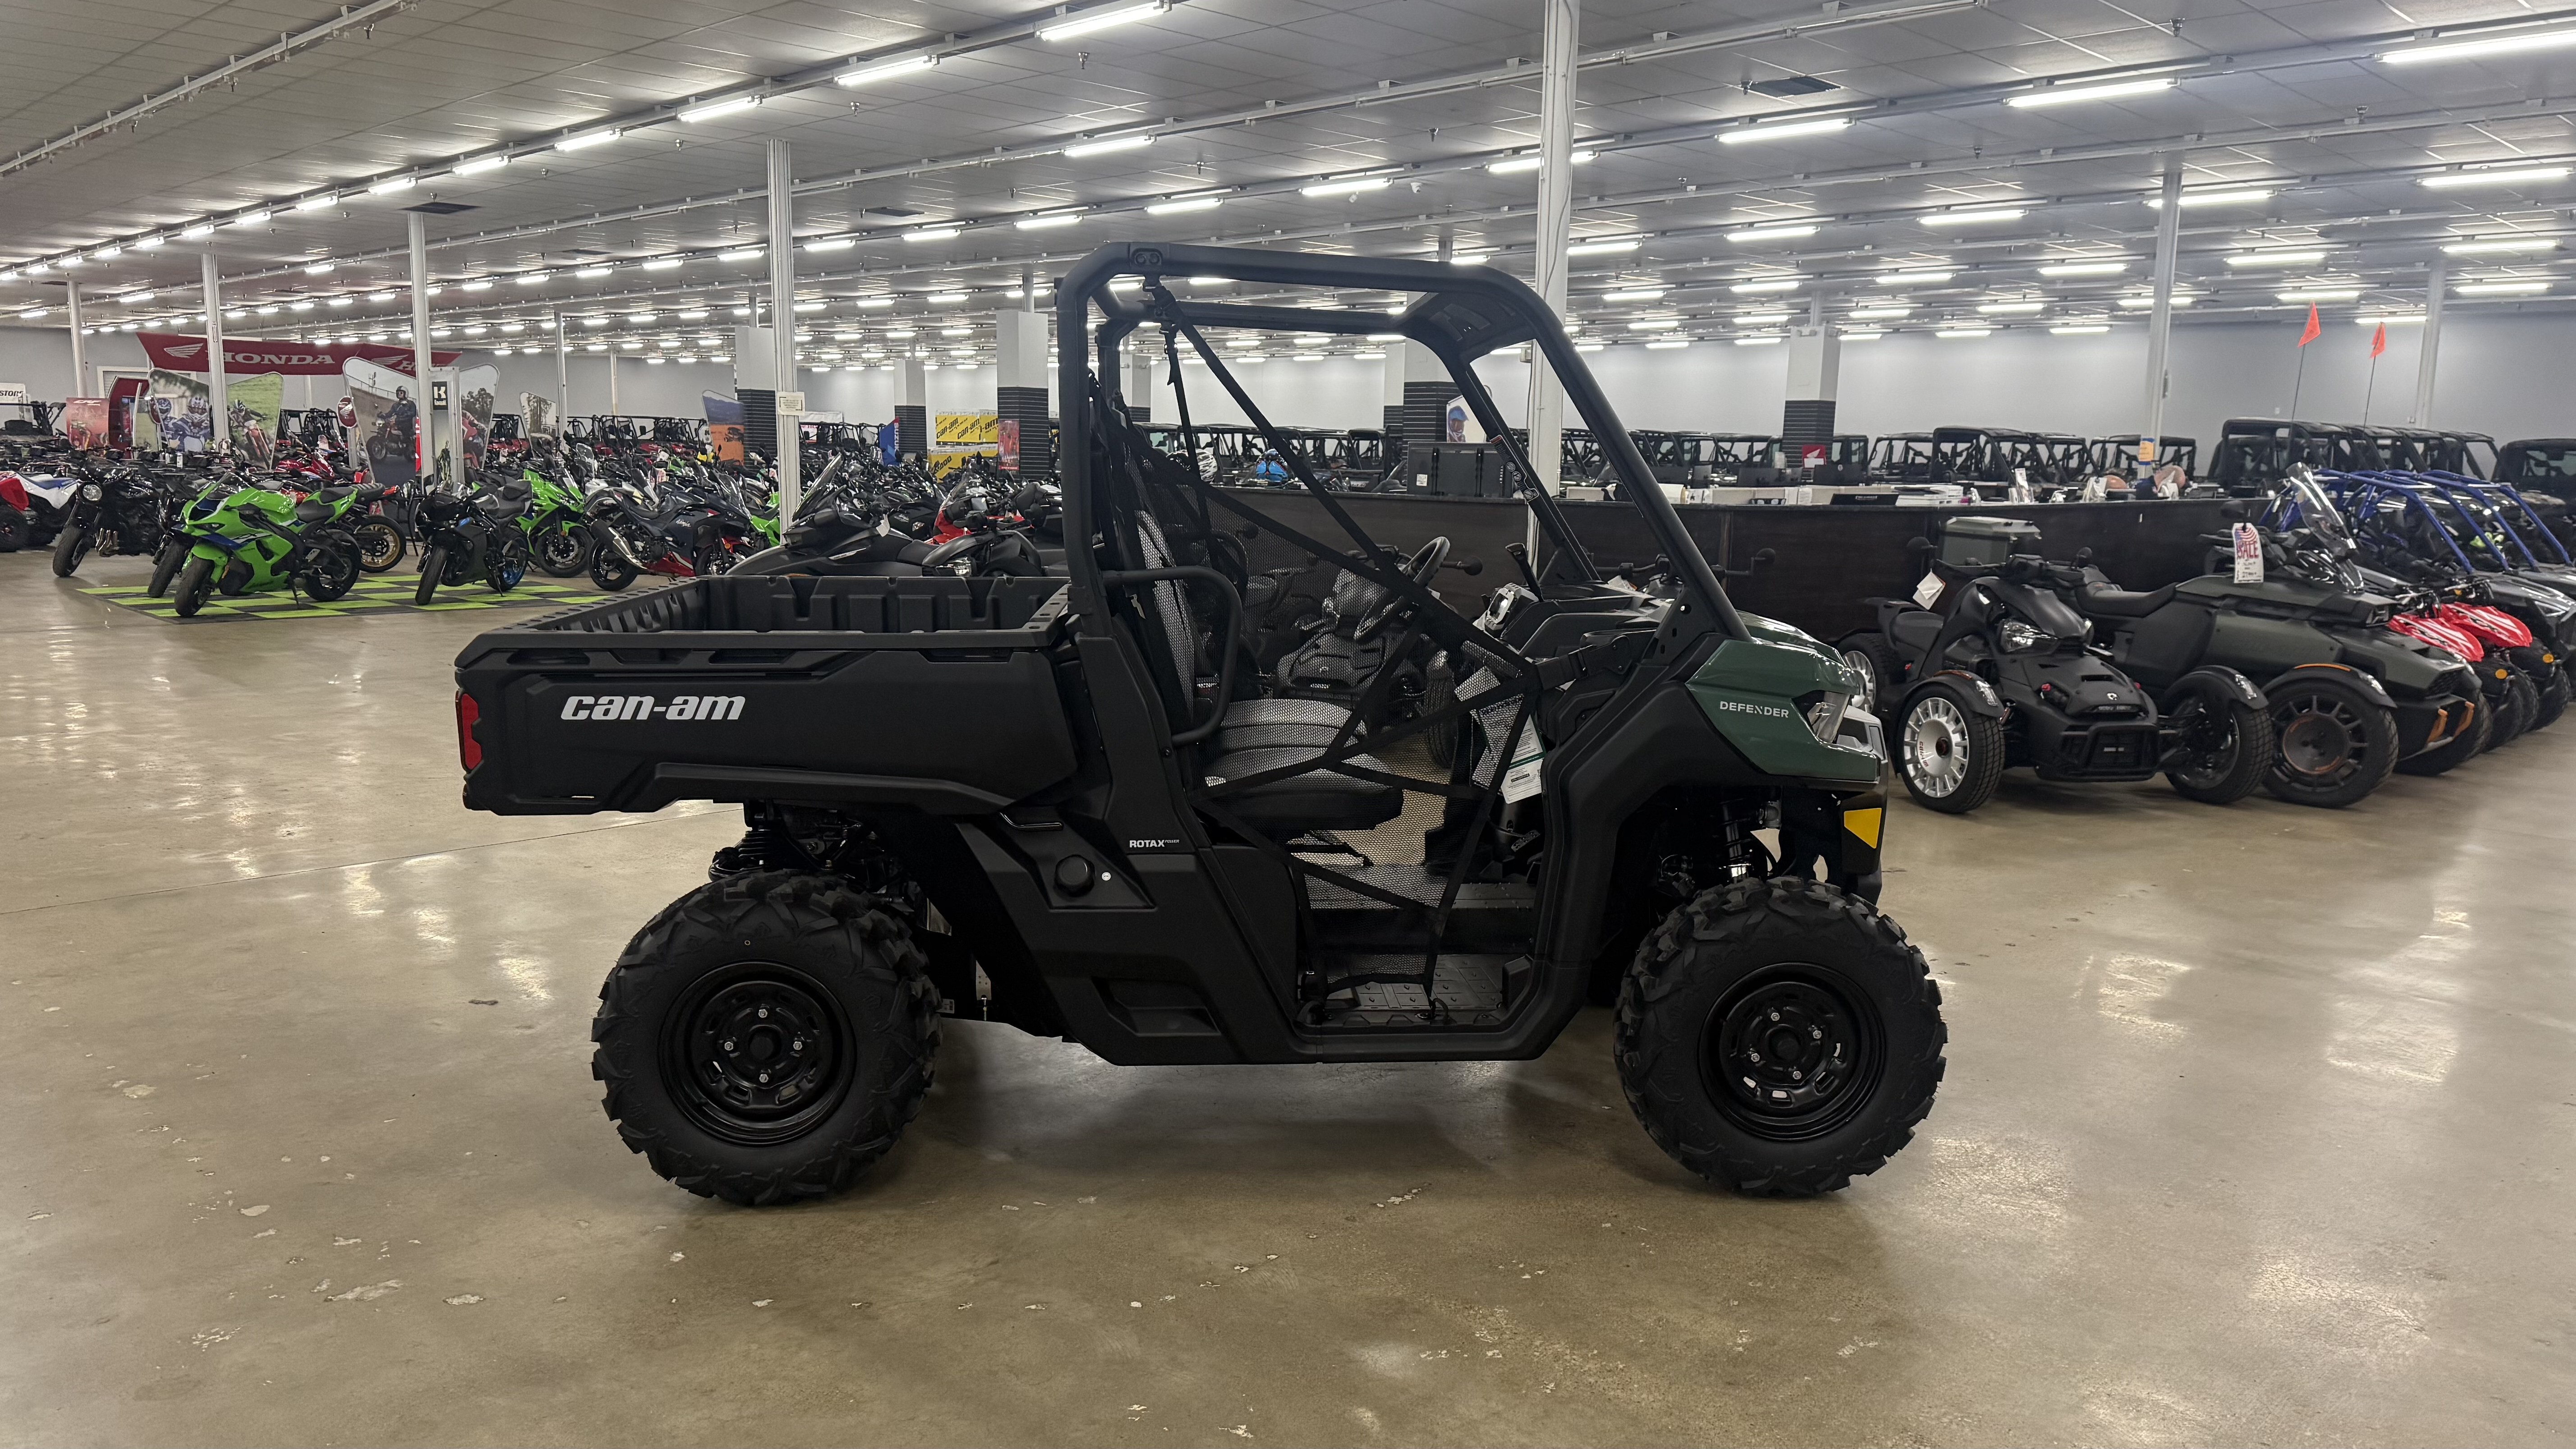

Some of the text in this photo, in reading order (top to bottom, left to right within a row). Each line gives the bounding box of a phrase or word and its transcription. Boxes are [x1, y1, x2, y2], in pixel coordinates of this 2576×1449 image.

[2237, 540, 2259, 559] SALE
[561, 696, 745, 720] can-am
[1720, 701, 1789, 718] DEFENDER
[1129, 839, 1164, 848] ROTAX
